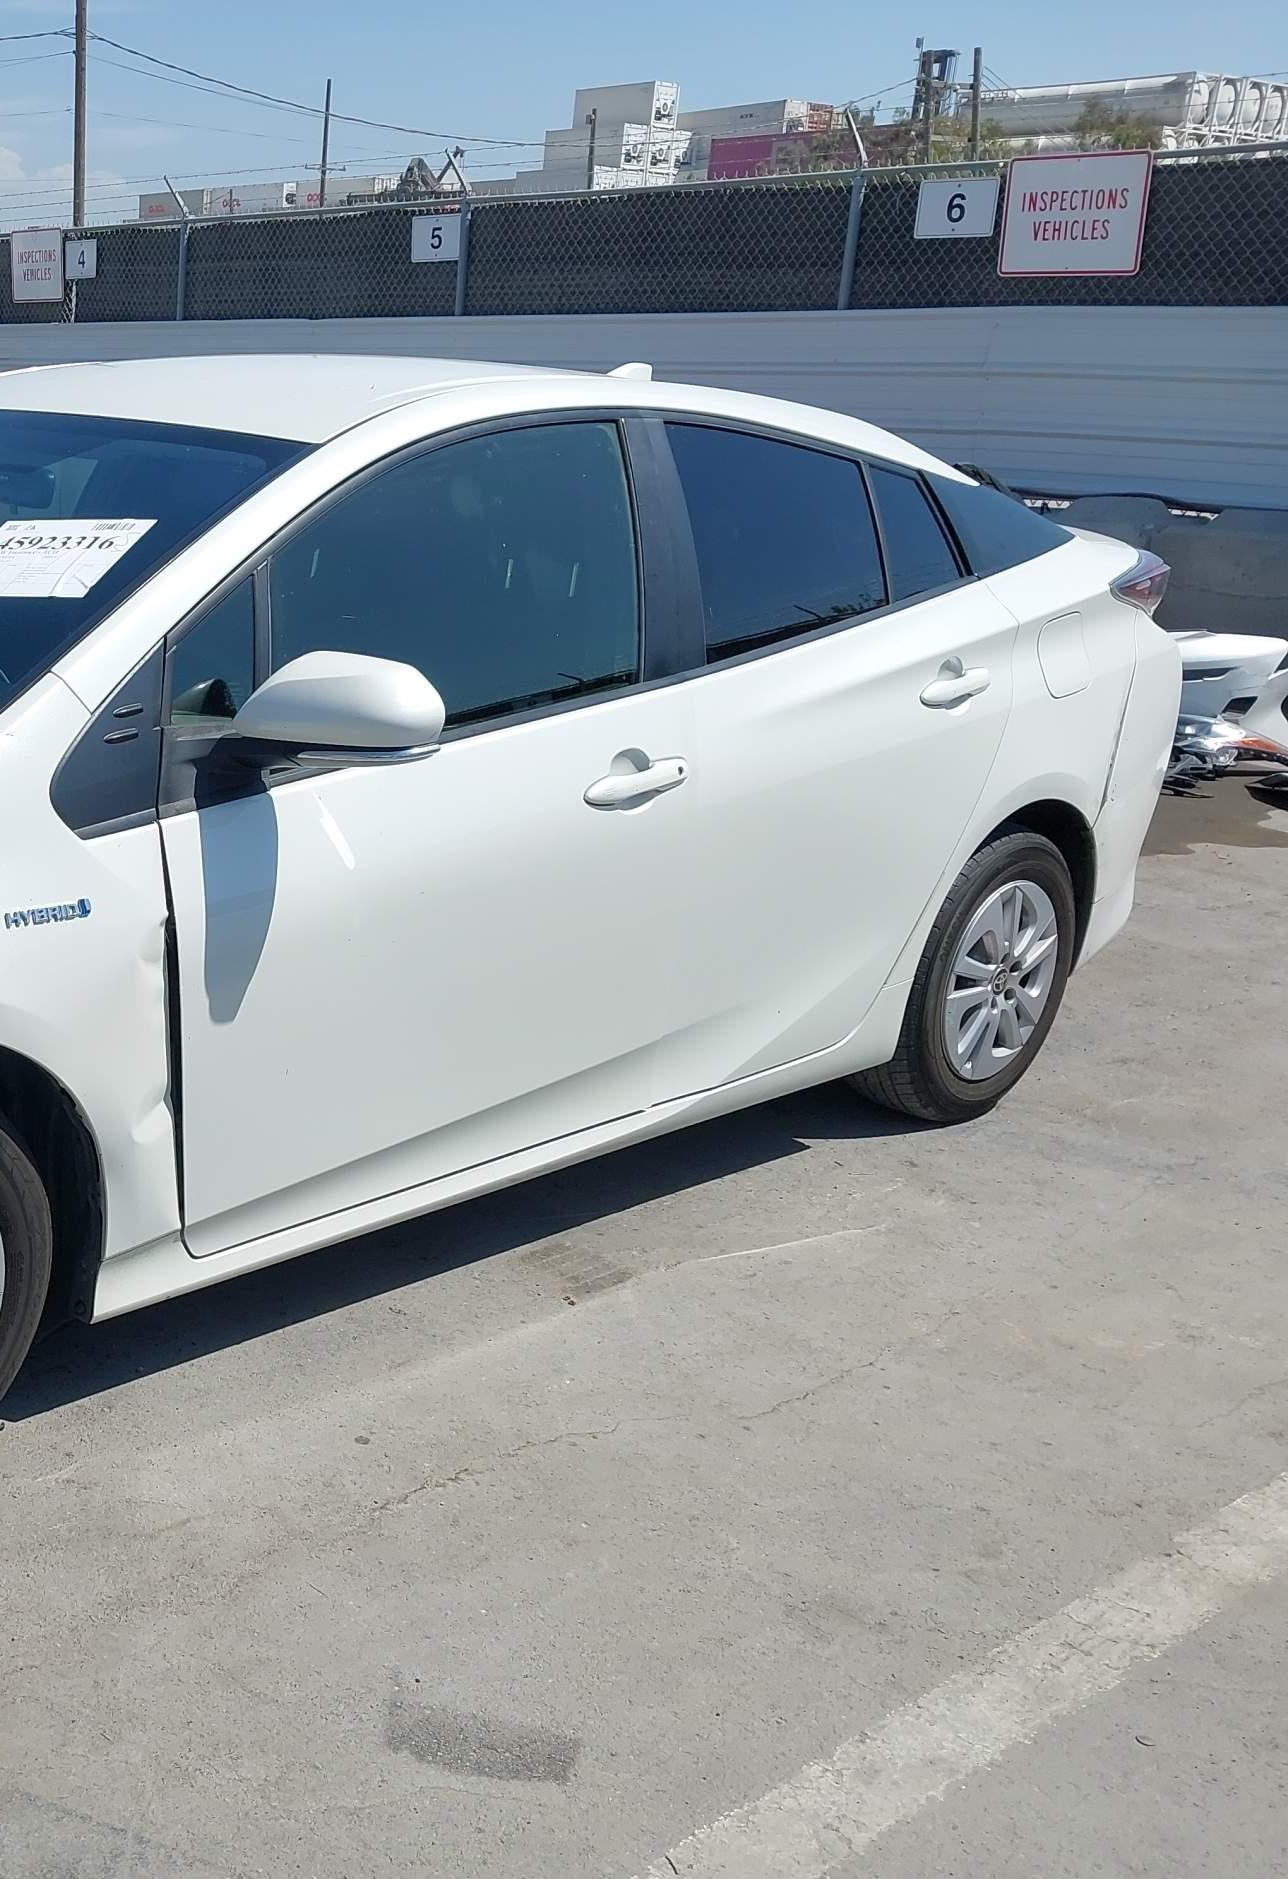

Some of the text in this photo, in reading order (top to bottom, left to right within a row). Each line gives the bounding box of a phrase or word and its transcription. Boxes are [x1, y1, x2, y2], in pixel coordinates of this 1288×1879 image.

[946, 192, 968, 223] 6
[1021, 187, 1130, 213] INSPECTIONS
[430, 226, 443, 250] 5
[1032, 218, 1111, 242] VEHICLES
[17, 248, 57, 265] INSPECTIONS
[77, 249, 86, 269] 4
[22, 267, 52, 282] VEHICLES
[3, 903, 78, 930] HYBRID
